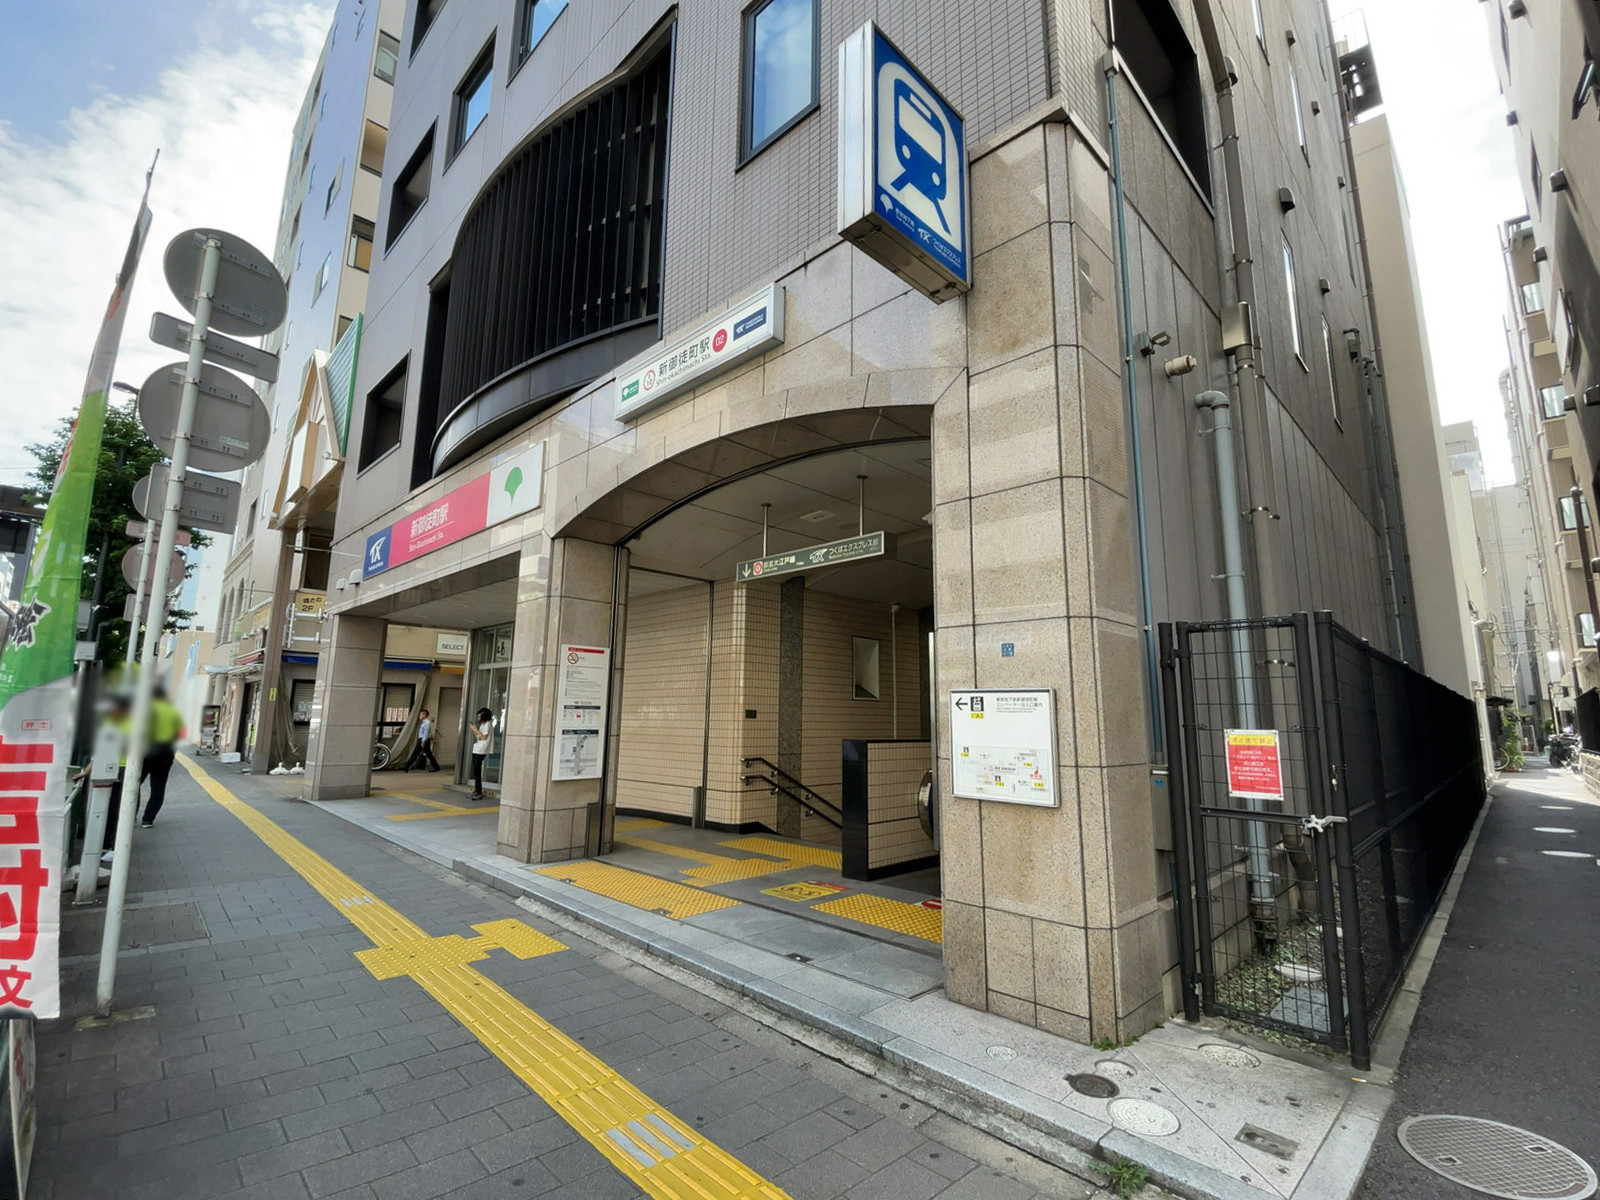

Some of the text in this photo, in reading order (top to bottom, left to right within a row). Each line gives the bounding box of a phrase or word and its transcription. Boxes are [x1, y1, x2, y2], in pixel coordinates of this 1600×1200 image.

[658, 336, 711, 376] 新御徒町駅
[410, 502, 450, 539] 新御徒町駅
[441, 643, 465, 651] SELECT
